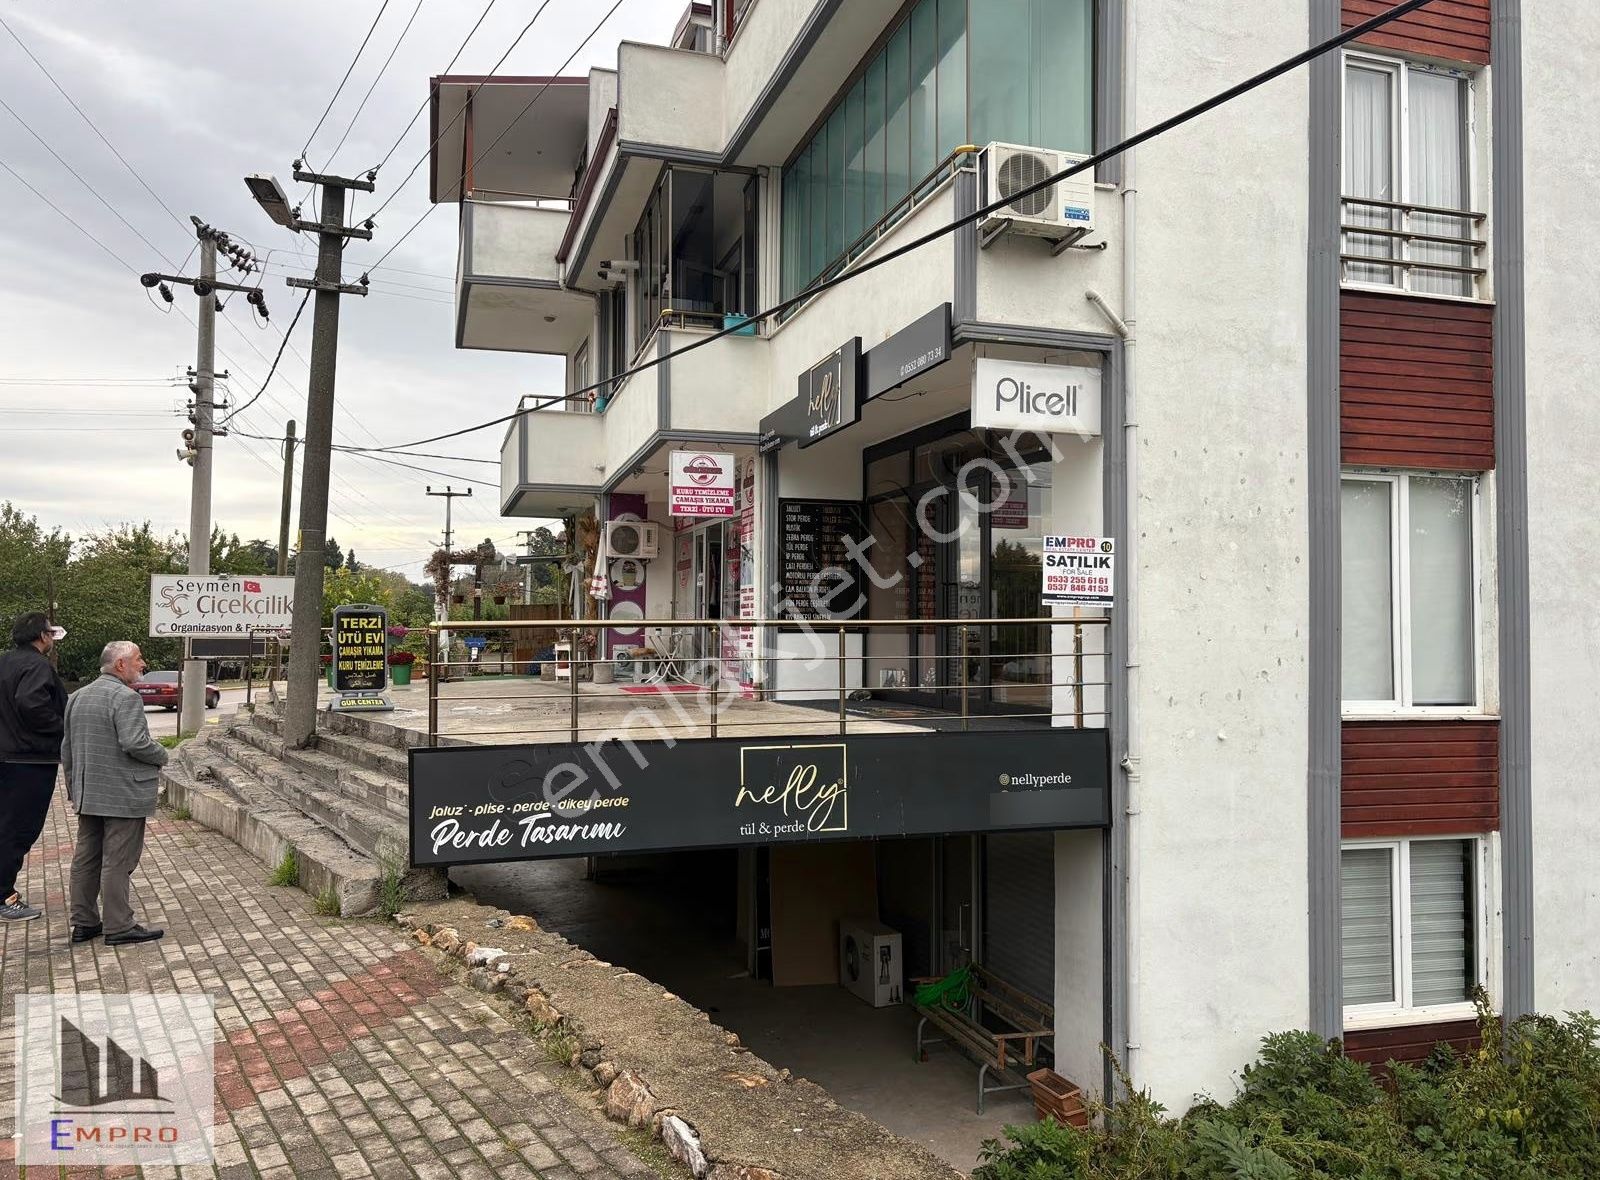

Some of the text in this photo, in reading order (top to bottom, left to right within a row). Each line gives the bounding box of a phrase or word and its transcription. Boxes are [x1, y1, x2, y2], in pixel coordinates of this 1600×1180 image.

[995, 377, 1077, 416] Plicell
[675, 496, 704, 504] ÇAMAŞIR
[1046, 537, 1111, 552] EMPRO 10
[1046, 555, 1111, 569] SATILIK
[176, 580, 240, 594] Seymen
[1070, 576, 1086, 584] 255
[1070, 584, 1086, 592] 846
[197, 595, 294, 619] Çiçekçilik
[171, 623, 233, 634] Organizasyon
[235, 623, 243, 632] &
[340, 616, 382, 629] TERZİ
[338, 630, 385, 644] ÜTÜ EVİ
[339, 646, 384, 659] ÇAMAŞIR YIKAMA
[339, 658, 384, 671] KURU TEMİZLEME
[1011, 773, 1072, 787] nellyperde
[736, 765, 847, 832] nelly
[429, 804, 467, 819] jaluz
[474, 803, 504, 816] plise
[513, 801, 550, 814] perde
[558, 798, 592, 812] dikey
[594, 796, 630, 808] perde
[430, 812, 627, 855] Perde Tasarımı
[740, 821, 805, 838] tül & perde
